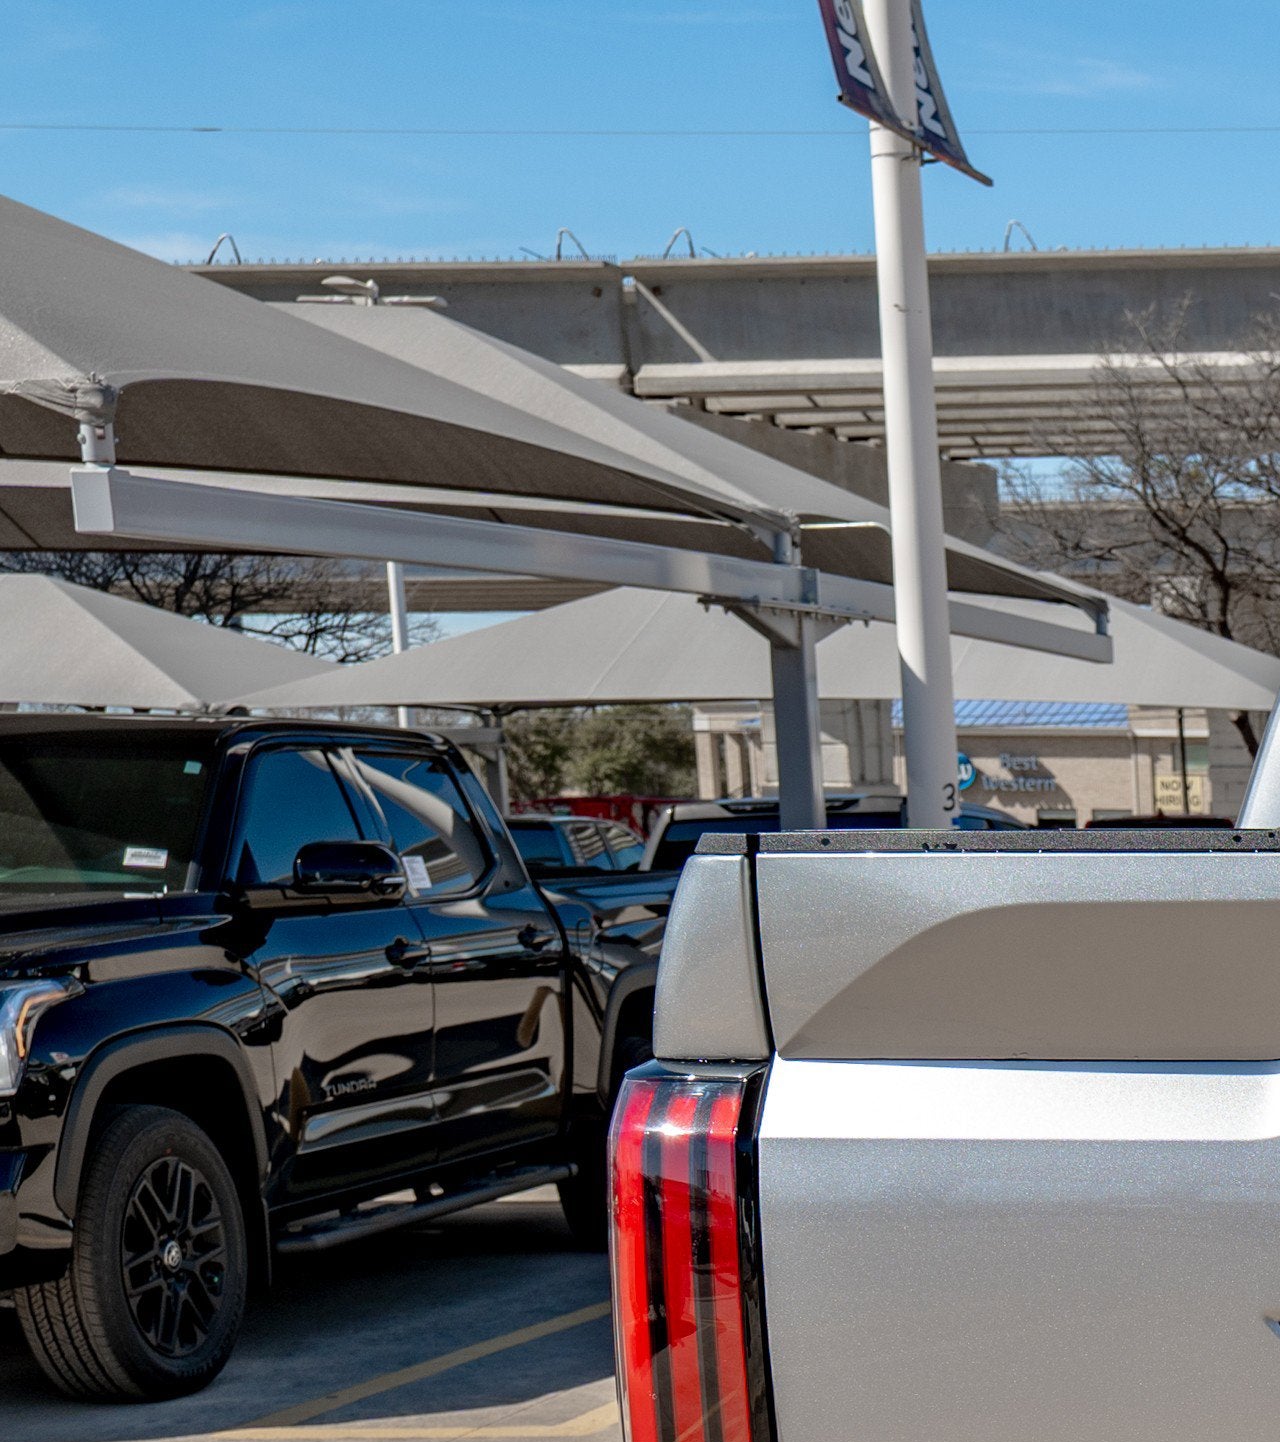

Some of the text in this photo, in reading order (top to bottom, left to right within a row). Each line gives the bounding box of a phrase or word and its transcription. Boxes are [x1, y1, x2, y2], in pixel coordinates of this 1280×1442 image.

[1000, 753, 1038, 771] Best
[982, 774, 1056, 792] Western
[943, 782, 956, 811] 3
[1154, 795, 1202, 807] HIRIG
[323, 1078, 378, 1098] TUNDRA
